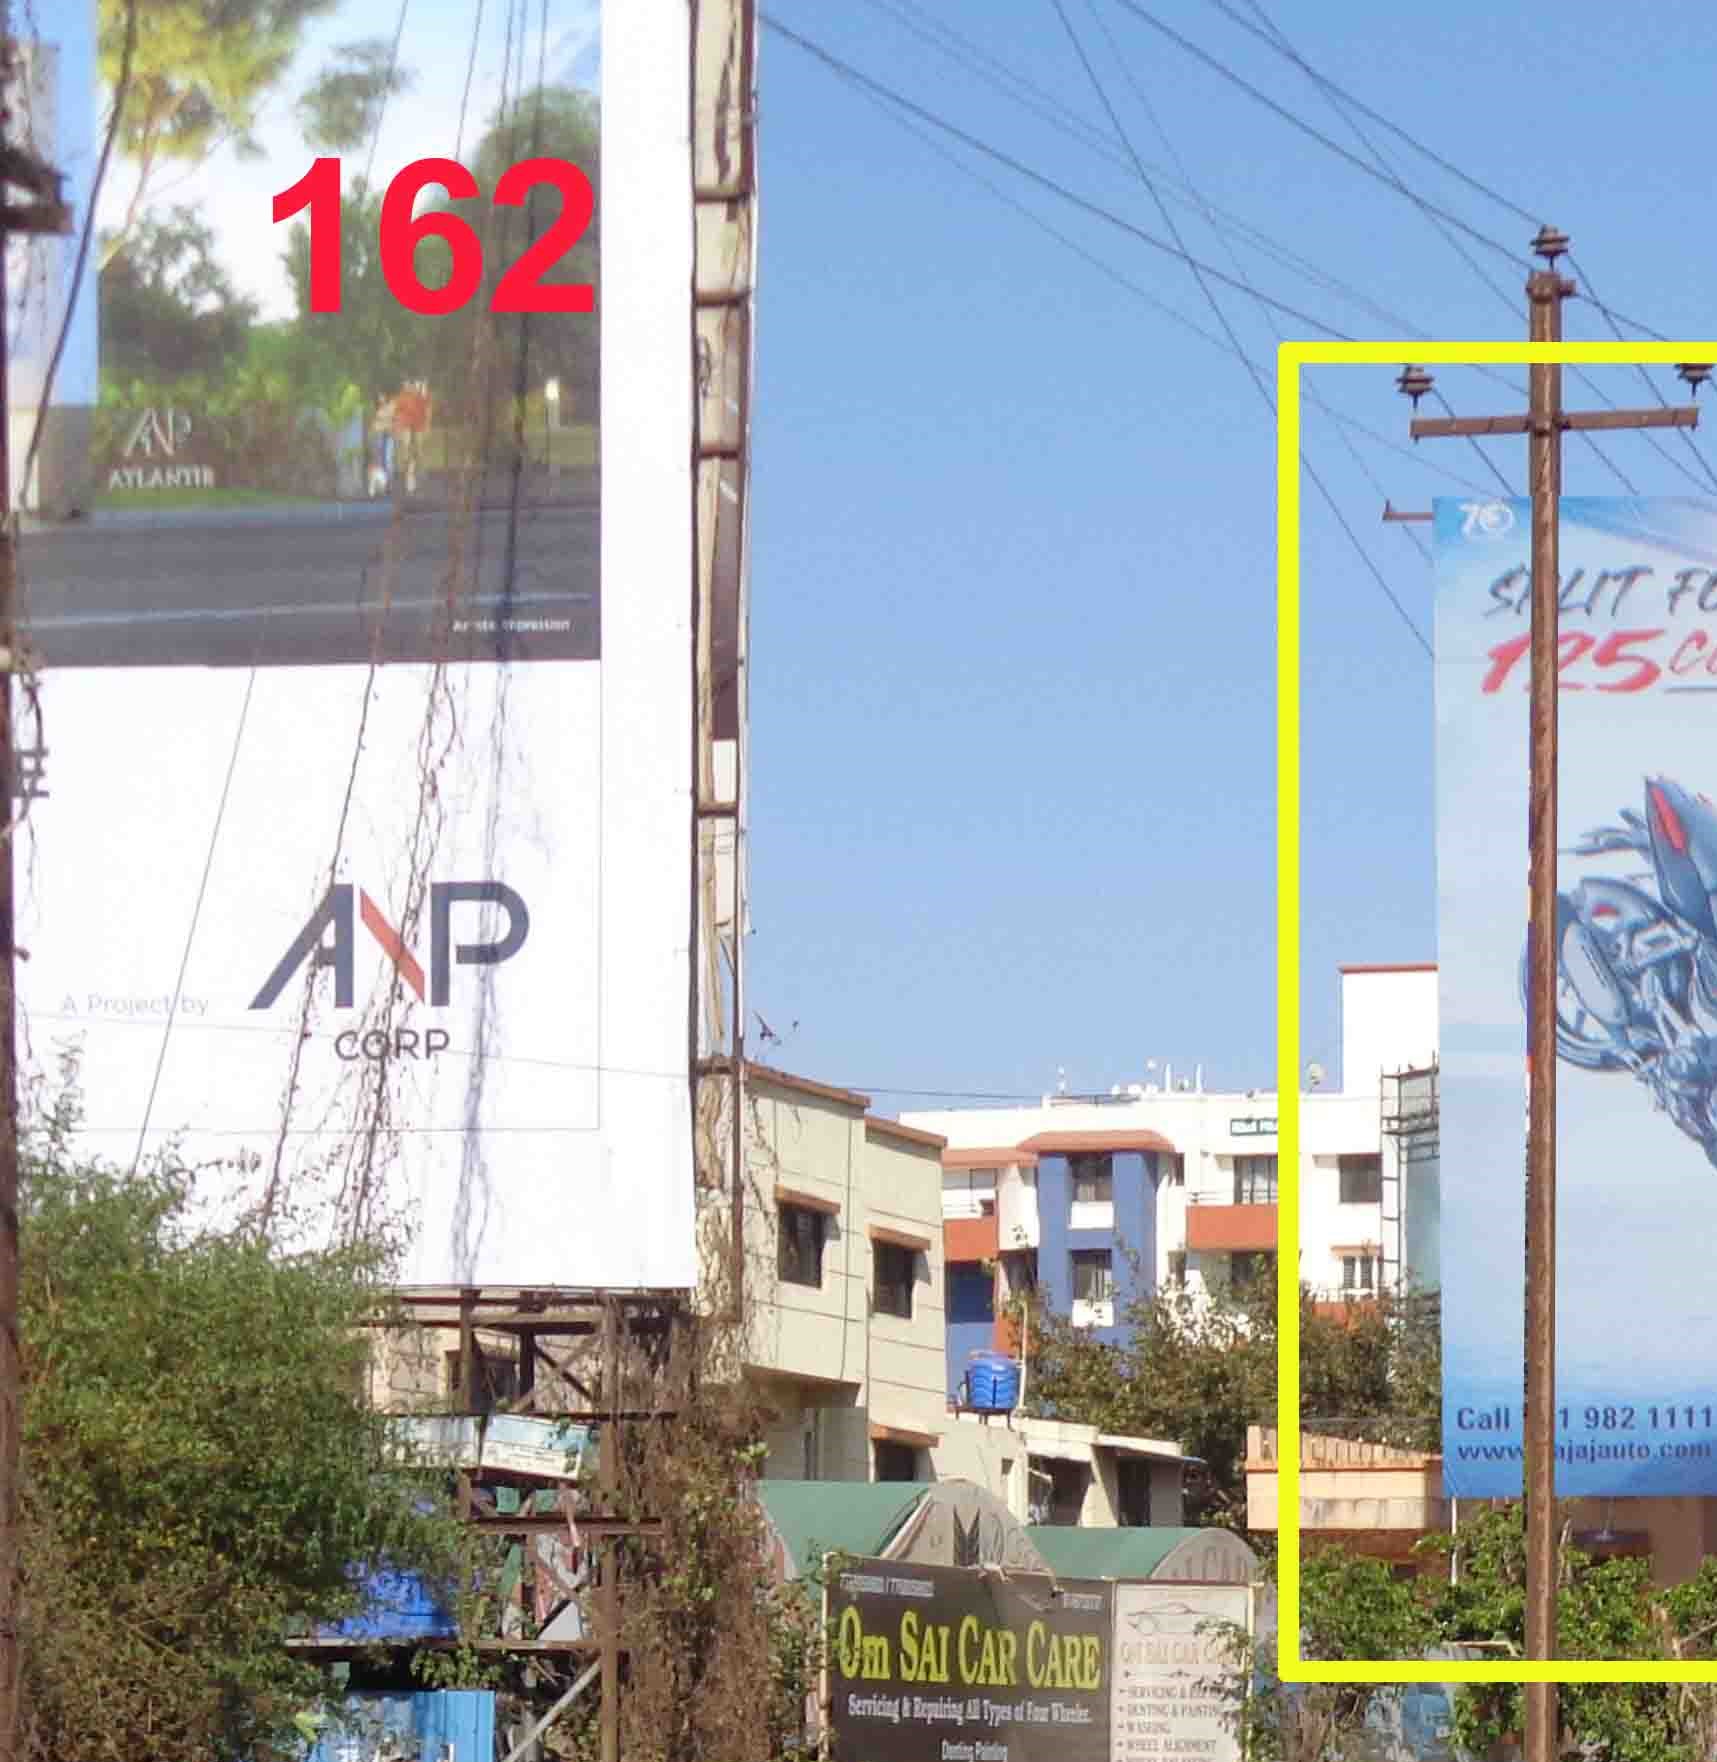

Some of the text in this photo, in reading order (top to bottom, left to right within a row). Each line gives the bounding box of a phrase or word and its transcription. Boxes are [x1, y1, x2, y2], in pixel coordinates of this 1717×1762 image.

[61, 994, 209, 1020] A Project by
[334, 1029, 449, 1061] CORP
[1457, 1408, 1511, 1430] Call
[1585, 1407, 1637, 1430] 982
[1647, 1406, 1712, 1429] 1111
[839, 1604, 1101, 1690] Om SAI CAR CARE
[848, 1693, 900, 1724] Servicing
[913, 1696, 963, 1726] Repairing
[966, 1698, 980, 1720] All
[983, 1699, 1012, 1727] Types
[1014, 1700, 1025, 1721] of
[1027, 1701, 1049, 1722] Four
